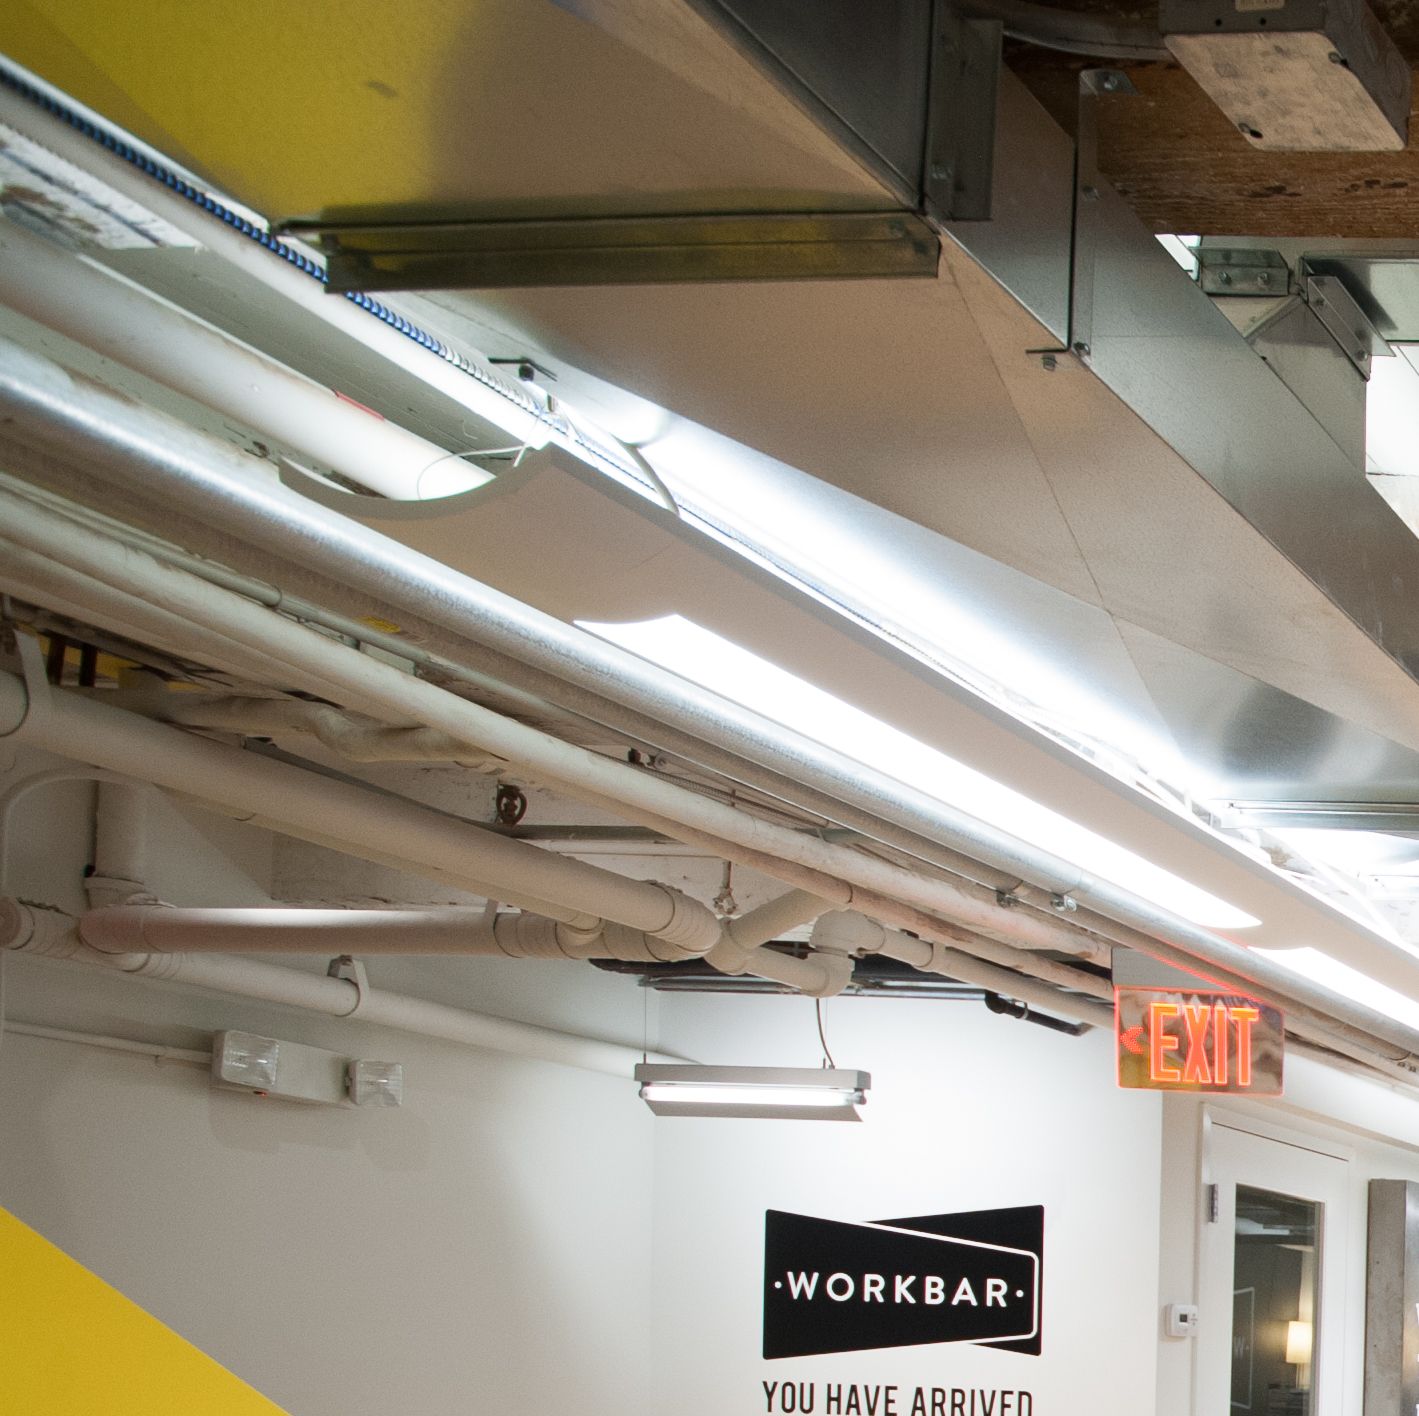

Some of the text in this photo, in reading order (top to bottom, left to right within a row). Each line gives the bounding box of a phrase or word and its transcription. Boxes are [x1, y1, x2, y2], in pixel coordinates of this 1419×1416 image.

[1148, 1001, 1260, 1087] EXIT
[786, 1271, 1008, 1308] WORKBAR
[762, 1381, 815, 1414] YOU
